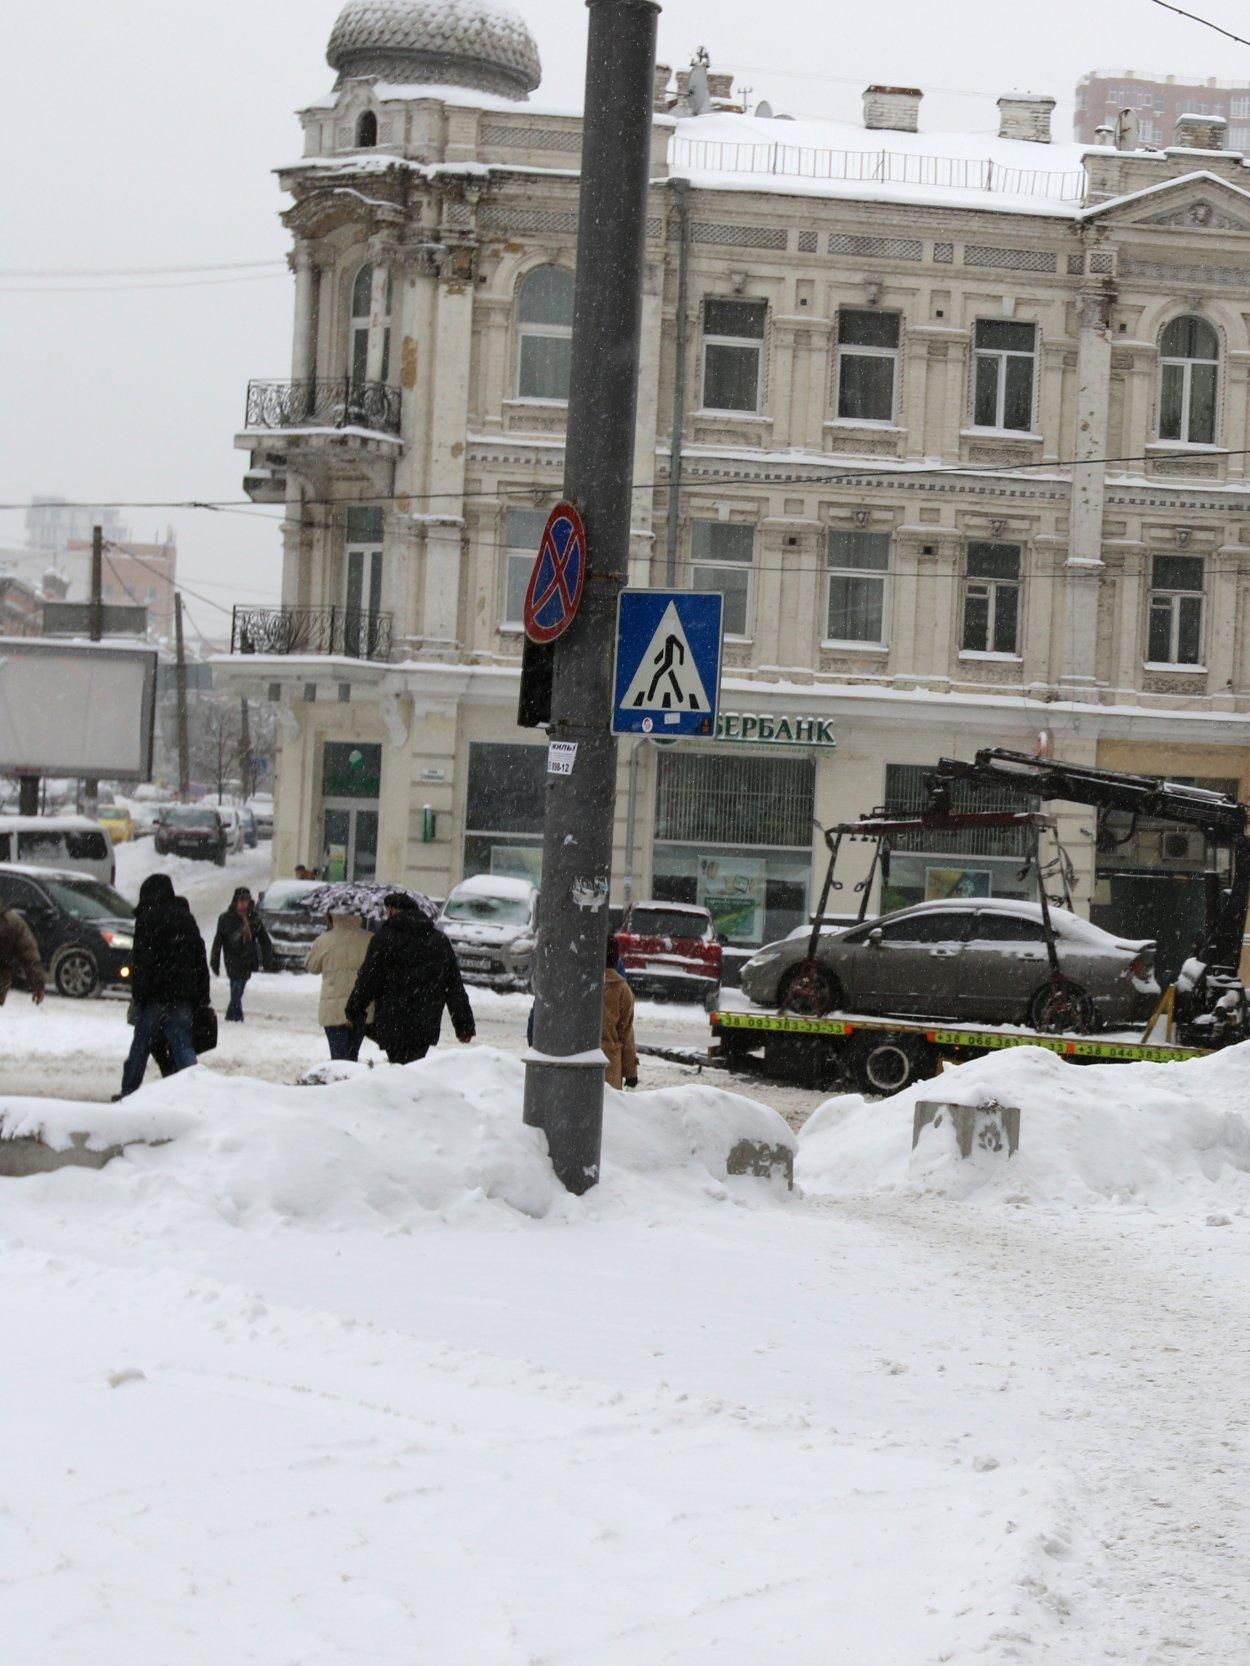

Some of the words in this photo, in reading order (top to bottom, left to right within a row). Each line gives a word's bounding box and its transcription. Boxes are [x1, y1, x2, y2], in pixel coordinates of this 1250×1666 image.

[748, 1019, 770, 1028] 093
[776, 1020, 842, 1033] 383-33-33
[937, 1034, 960, 1044] +38
[1078, 1046, 1101, 1056] +38
[1110, 1048, 1133, 1058] 044
